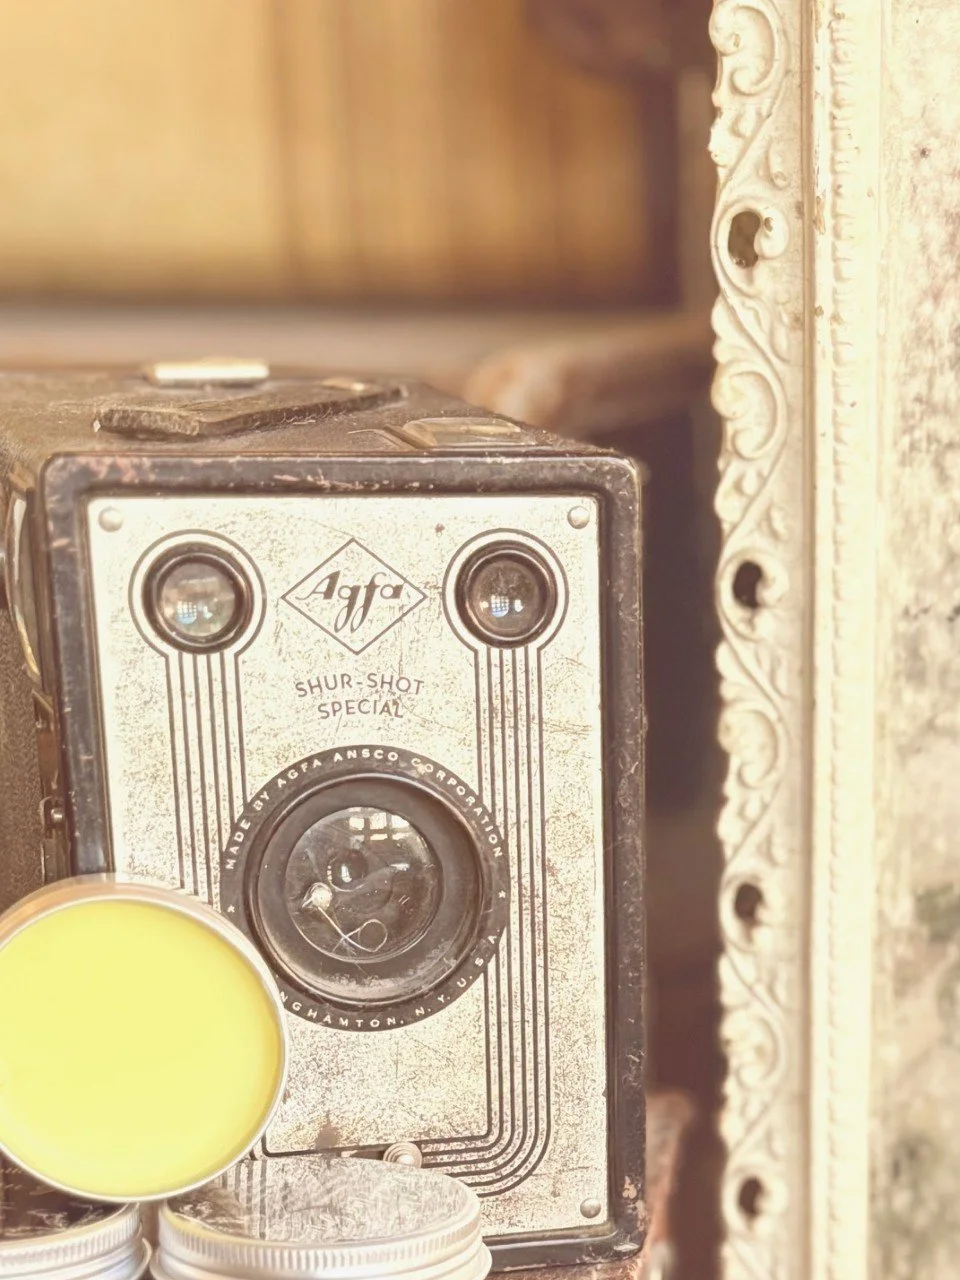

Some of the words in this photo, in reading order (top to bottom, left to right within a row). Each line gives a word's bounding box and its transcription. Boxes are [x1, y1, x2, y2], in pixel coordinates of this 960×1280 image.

[294, 570, 404, 634] Agfa
[294, 672, 425, 698] SHUR-SHOT
[317, 698, 404, 720] SPECIAL
[225, 819, 252, 870] MADE
[253, 790, 270, 811] BY
[277, 758, 322, 788] AGFA
[333, 748, 399, 762] ANSCO
[411, 757, 503, 858] CORPORATION
